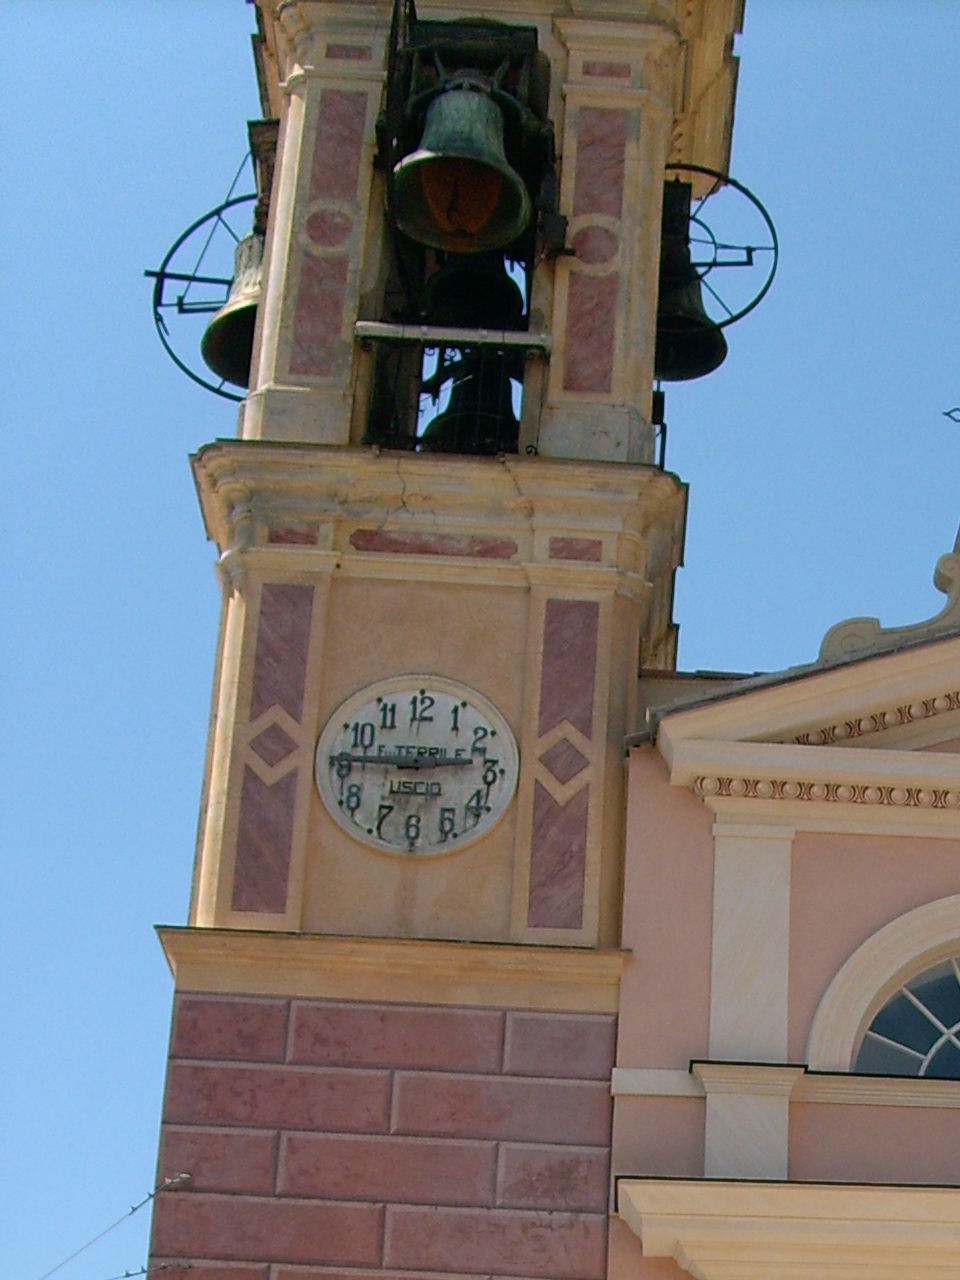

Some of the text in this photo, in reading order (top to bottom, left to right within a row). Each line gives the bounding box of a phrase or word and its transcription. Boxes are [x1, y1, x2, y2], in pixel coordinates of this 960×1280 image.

[380, 703, 396, 729] 11
[410, 696, 435, 721] 12
[451, 706, 459, 731] 1
[351, 722, 375, 748] 10
[471, 727, 487, 755] 2
[483, 759, 499, 785] 3
[346, 784, 361, 811] 8
[465, 790, 483, 816] 4
[377, 805, 394, 835] 7
[406, 815, 421, 840] 6
[440, 808, 455, 835] 5
